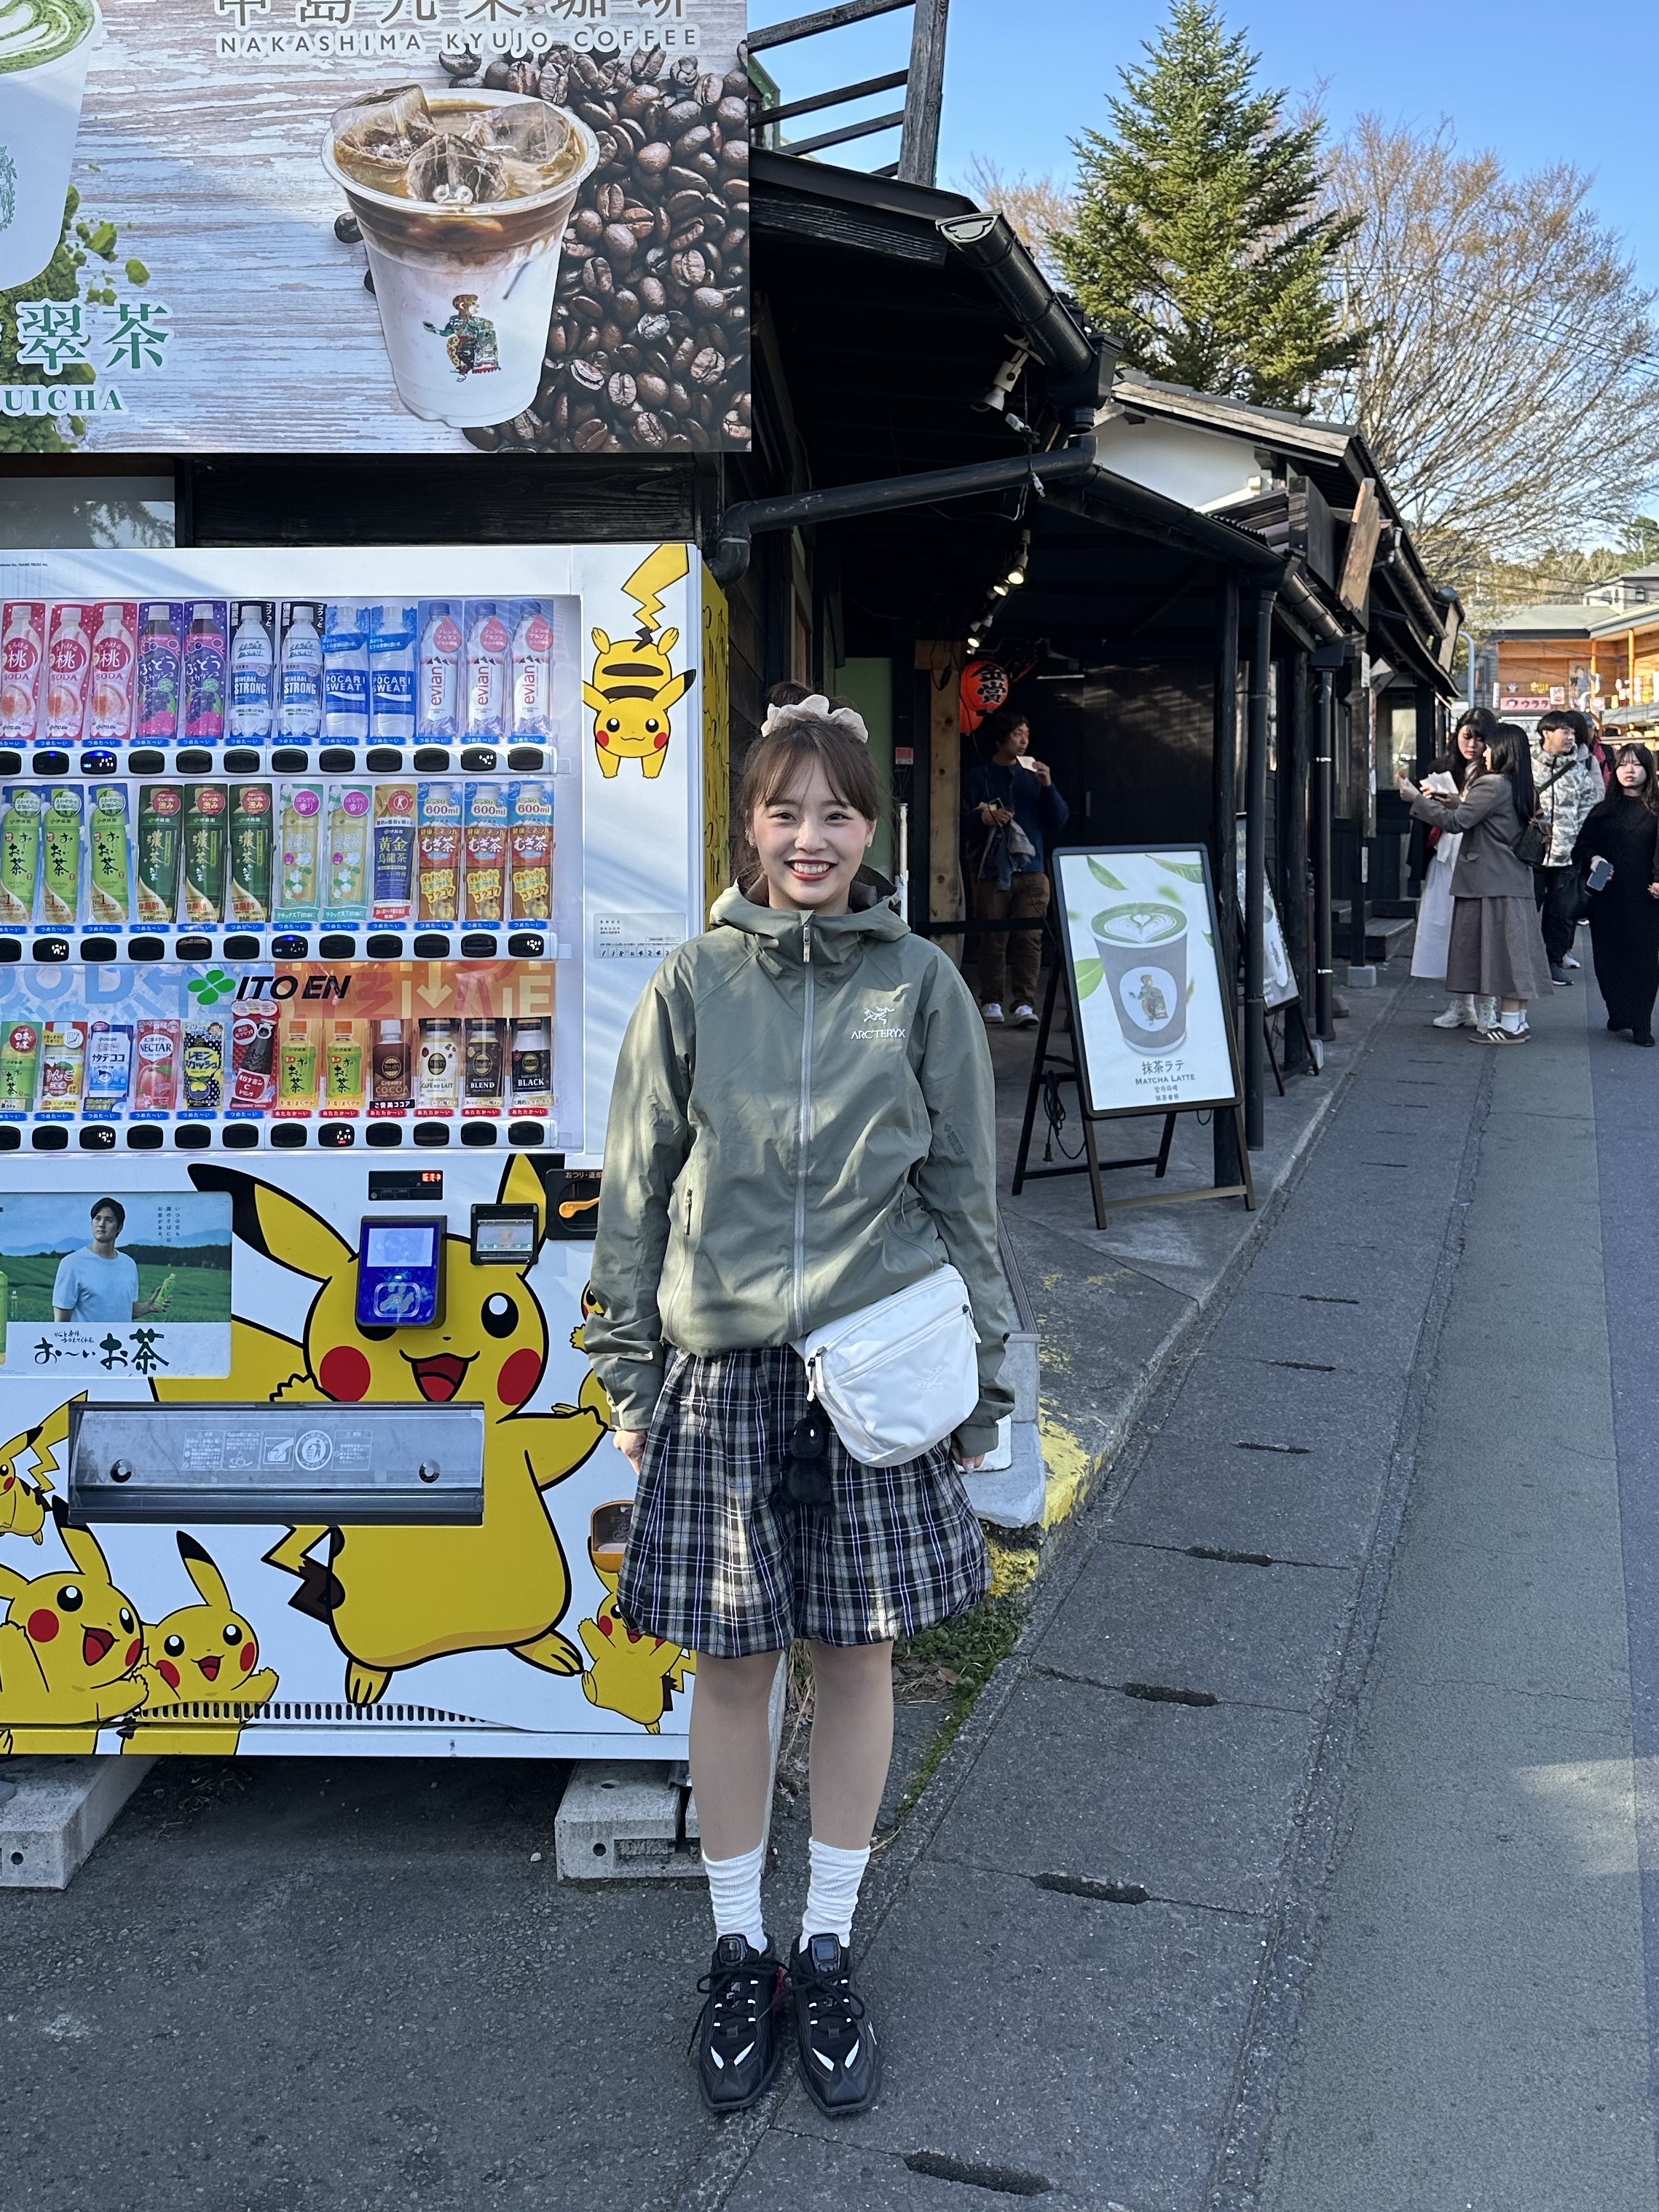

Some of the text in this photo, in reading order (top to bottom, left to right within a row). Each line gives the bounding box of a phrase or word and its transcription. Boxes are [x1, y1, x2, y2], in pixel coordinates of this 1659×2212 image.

[221, 29, 695, 53] NAKASHIMA KYUJO COFFEE
[20, 303, 170, 370] 翠茶
[4, 390, 123, 411] UICHA
[8, 650, 27, 669] 桃
[55, 650, 76, 669] 桃
[99, 650, 120, 668] 桃
[139, 655, 176, 675] ぶどう
[186, 655, 221, 675] ぶどう
[3, 673, 29, 681] SODA
[51, 674, 78, 682] SODA
[95, 672, 123, 680] SODA
[326, 674, 366, 685] POCARI
[372, 676, 411, 685] POCARI
[234, 682, 267, 695] STRONG
[283, 682, 317, 695] STRONG
[326, 683, 362, 692] SWEAT
[372, 684, 408, 693] SWEAT
[430, 665, 443, 706] evian
[477, 665, 489, 706] evian
[522, 664, 535, 705] evian
[971, 664, 1007, 704] 金賞
[299, 803, 314, 811] 香り
[349, 803, 363, 811] 香り
[425, 806, 459, 816] 600ml
[473, 806, 506, 816] 600ml
[518, 804, 551, 814] 600ml
[420, 827, 459, 835] 健康ミネラル
[467, 827, 506, 835] 健康ミネラル
[512, 827, 550, 835] 健康ミネラル
[379, 835, 409, 853] 黄金
[421, 835, 457, 853] むぎ茶
[468, 835, 503, 853] むぎ茶
[513, 835, 548, 852] むぎ茶
[236, 975, 352, 1000] ITO EN
[850, 1028, 906, 1040] ARC'TERYX
[140, 1043, 173, 1052] NECTAR
[92, 1053, 125, 1063] ナタデココ
[188, 1050, 214, 1060] レモン
[186, 1058, 219, 1069] スカッシュ
[1141, 1059, 1185, 1076] 抹茶ラテ
[46, 1069, 76, 1082] りんご
[239, 1074, 263, 1087] オロナミン
[1135, 1074, 1196, 1086] MATCHA LATTE
[517, 1079, 545, 1087] BLACK
[375, 1085, 409, 1094] COCOA
[374, 1101, 410, 1109] ご褒美ココア
